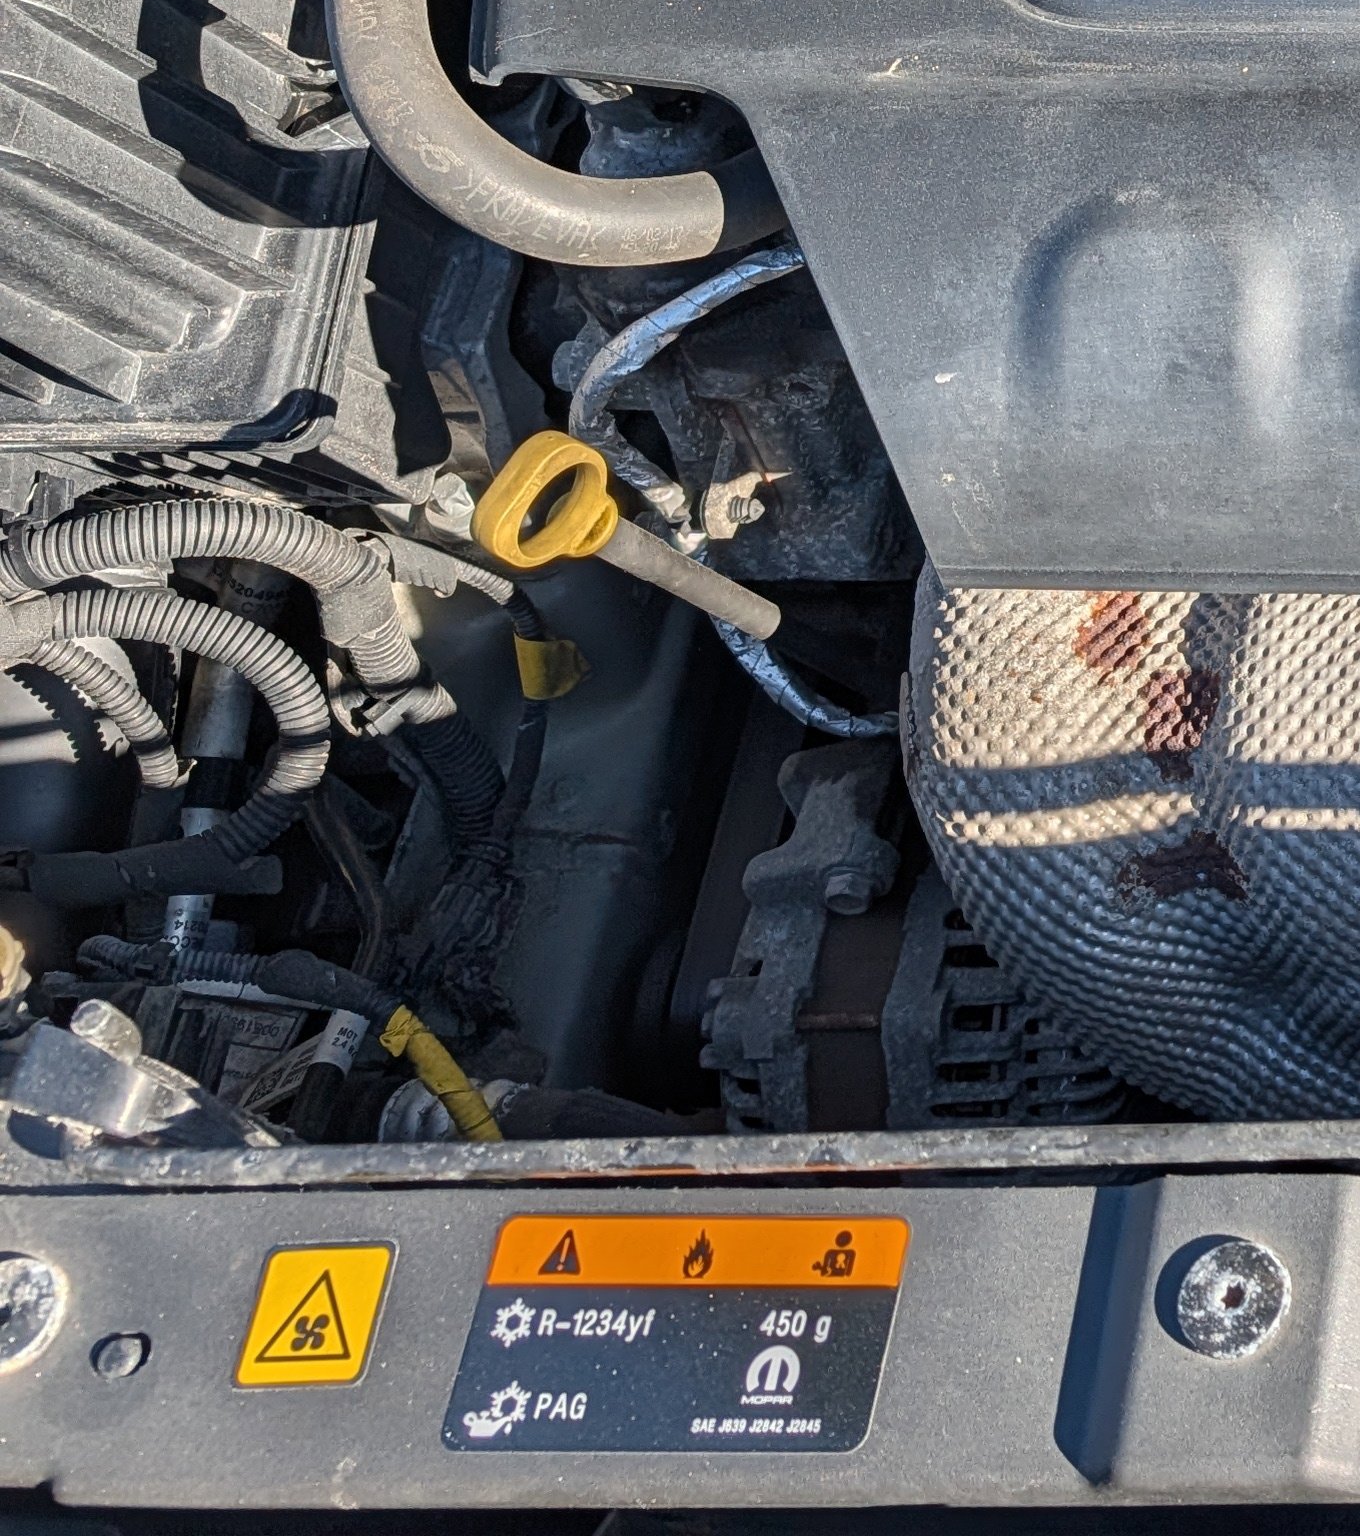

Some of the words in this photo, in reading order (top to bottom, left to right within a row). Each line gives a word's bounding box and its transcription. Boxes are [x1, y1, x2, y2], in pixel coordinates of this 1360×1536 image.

[536, 1309, 656, 1337] R-1234yf
[758, 1310, 805, 1336] 450
[813, 1315, 832, 1343] g
[532, 1391, 588, 1420] PAG
[740, 1393, 793, 1405] MOPAR
[690, 1418, 716, 1434] SAE
[718, 1418, 745, 1434] J639
[748, 1418, 784, 1434] J2842
[786, 1418, 821, 1434] J2845
